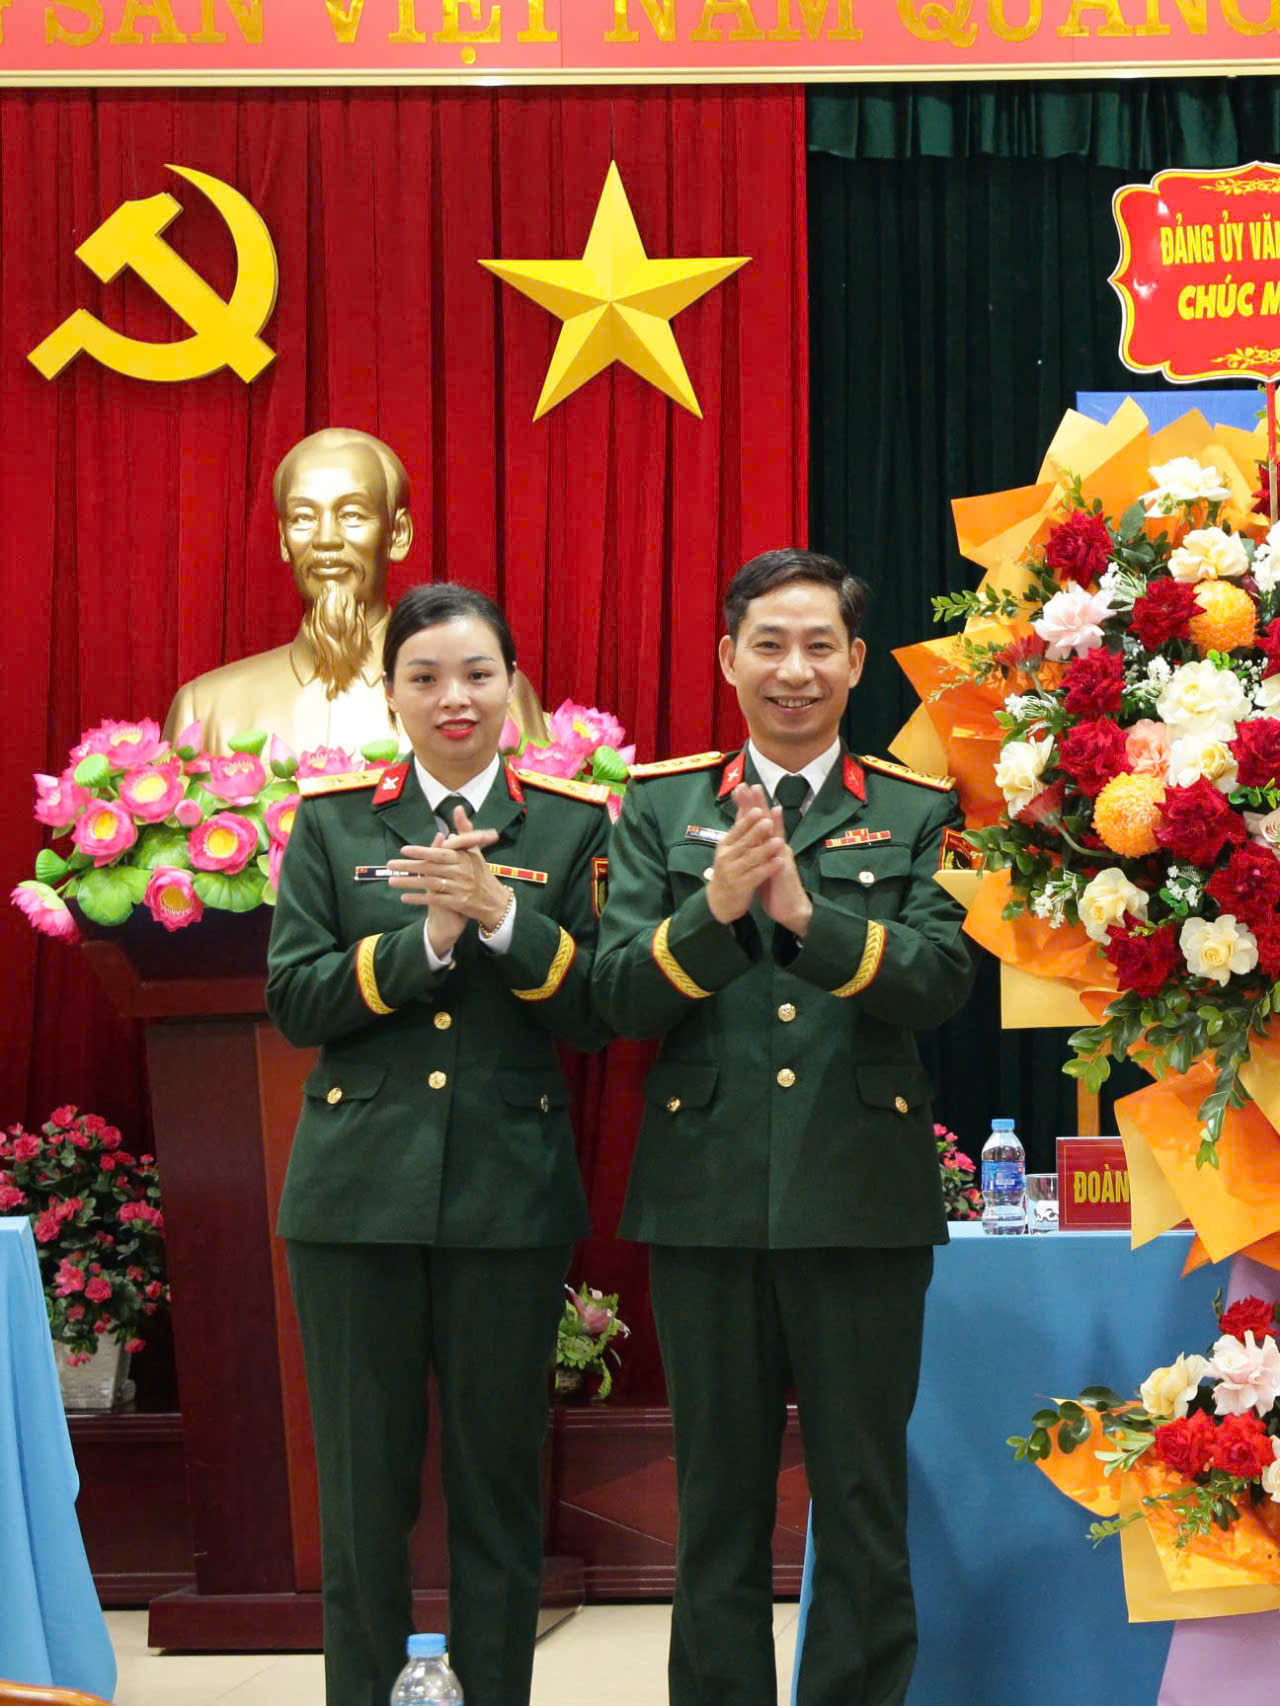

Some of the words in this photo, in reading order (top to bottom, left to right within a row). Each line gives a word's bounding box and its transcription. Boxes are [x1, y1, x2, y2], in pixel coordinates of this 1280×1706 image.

[1160, 213, 1215, 265] ĐẢNG
[1219, 210, 1244, 261] ỦY
[1178, 274, 1255, 320] CHÚC
[1074, 1163, 1130, 1204] ĐOÀN
